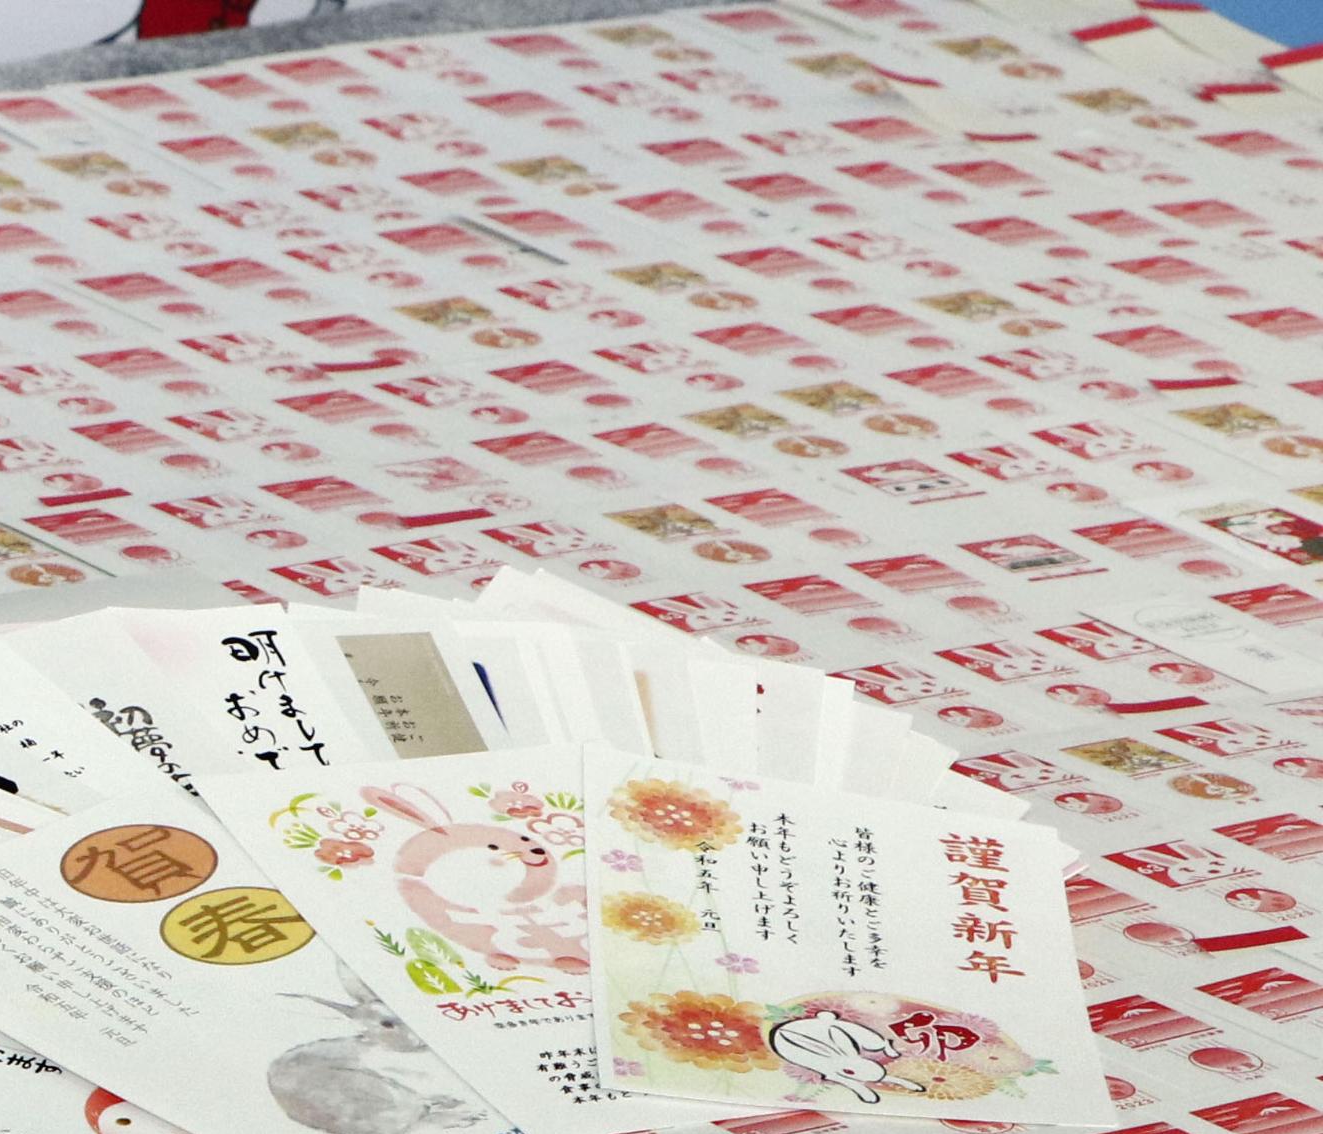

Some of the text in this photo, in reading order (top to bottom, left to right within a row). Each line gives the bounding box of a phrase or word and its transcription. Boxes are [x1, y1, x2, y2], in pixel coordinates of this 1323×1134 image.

[221, 629, 331, 767] 明けまして
[695, 840, 722, 932] 令和五年 元旦
[746, 822, 779, 942] お願い申し上げます
[773, 812, 798, 945] 本年もどうぞよろしく
[828, 838, 860, 978] 心よりお祈りいたします
[855, 826, 888, 970] 皆様のご健康とご多幸を
[939, 833, 1026, 984] 謹賀新年
[887, 1012, 981, 1062] 卯
